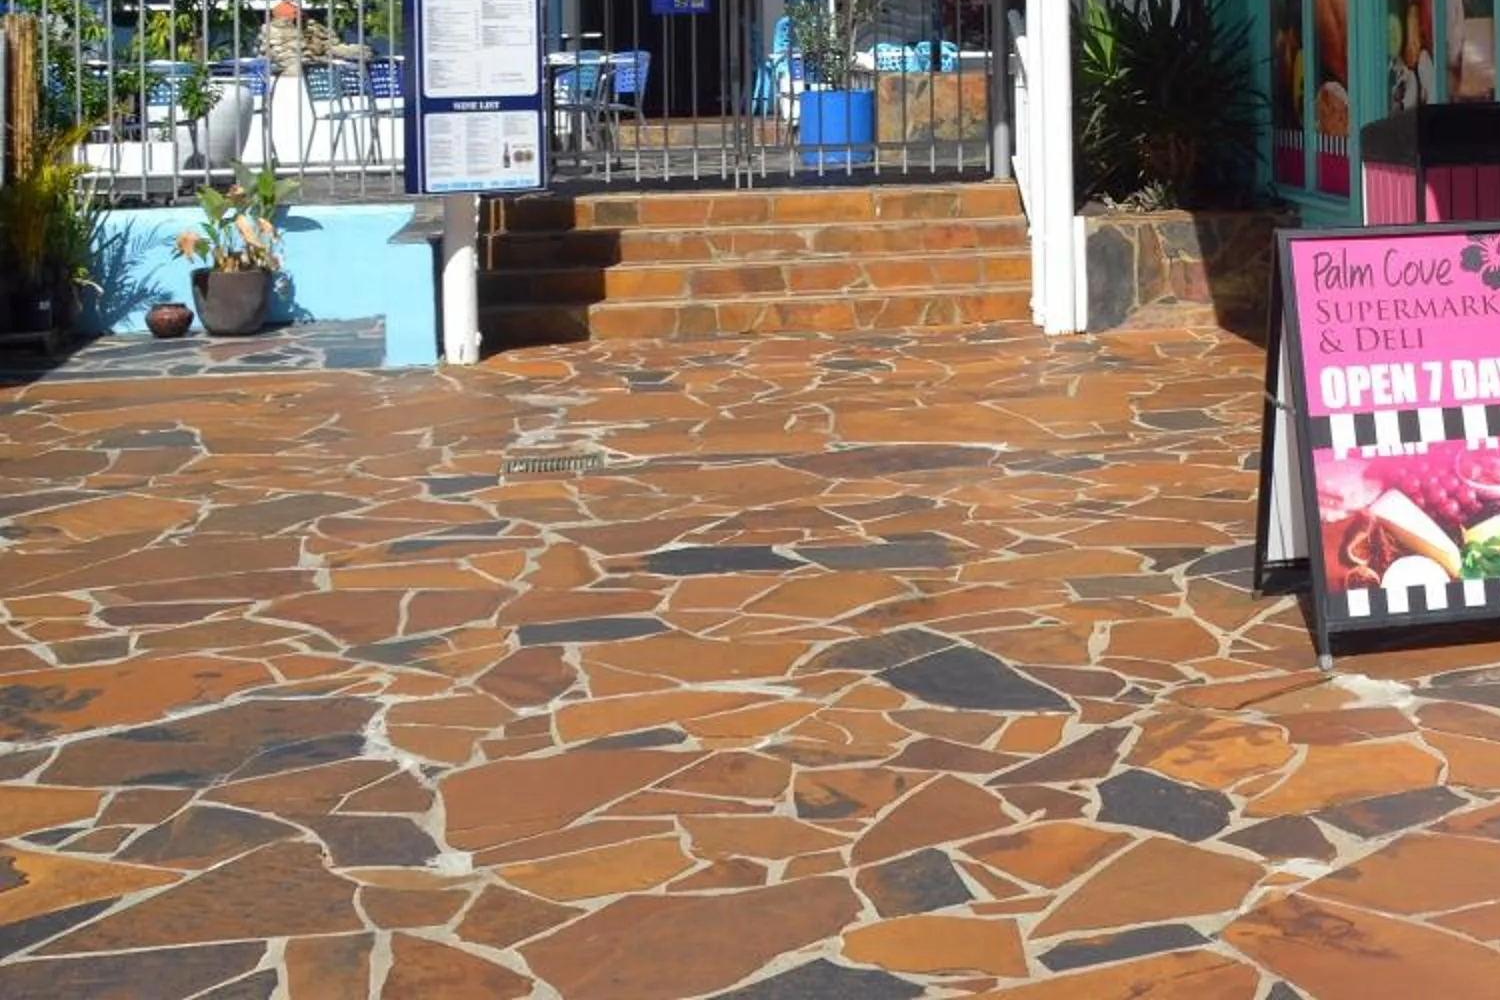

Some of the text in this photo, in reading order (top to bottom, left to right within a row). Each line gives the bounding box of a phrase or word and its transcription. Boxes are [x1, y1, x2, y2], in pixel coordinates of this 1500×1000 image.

[1313, 248, 1454, 292] Palm Cove
[1319, 327, 1424, 354] & DELI
[1320, 362, 1417, 410] OPEN
[1421, 361, 1443, 401] 7
